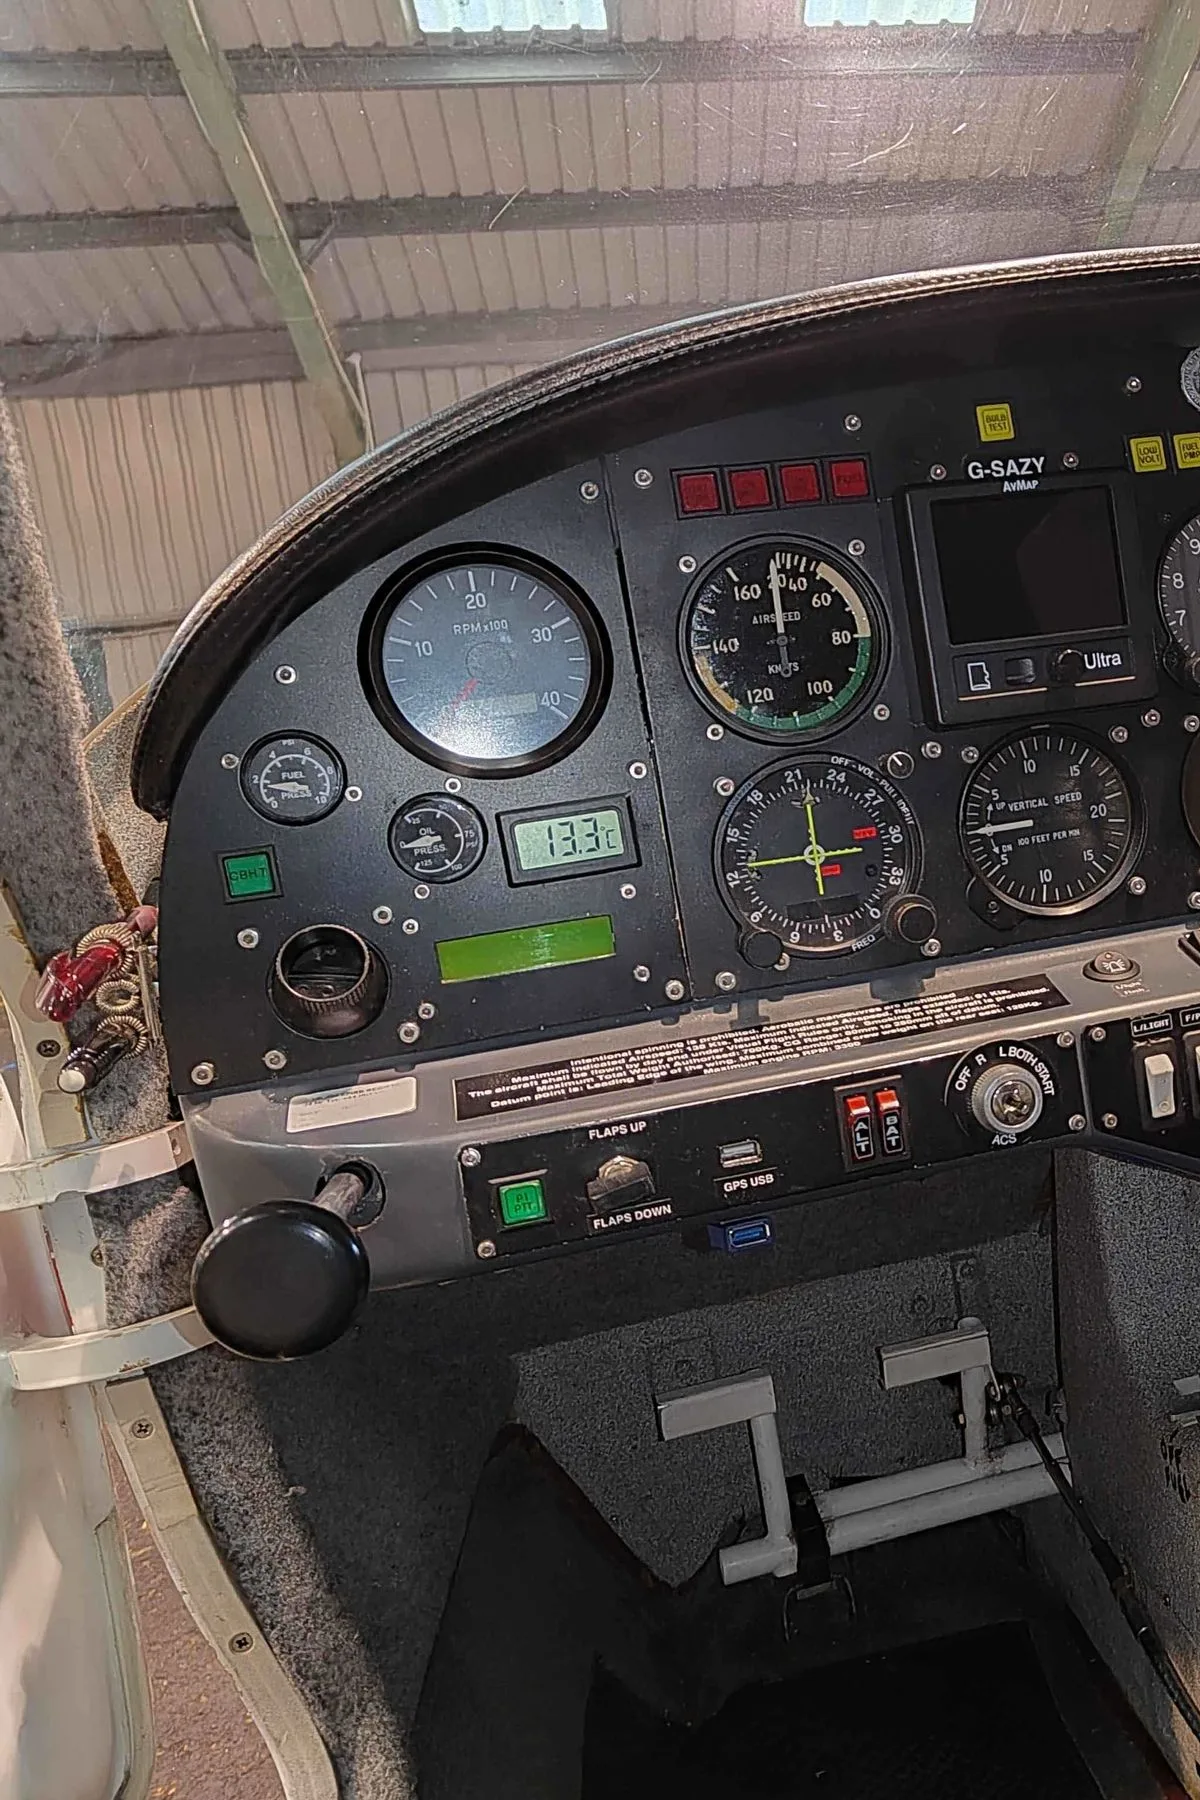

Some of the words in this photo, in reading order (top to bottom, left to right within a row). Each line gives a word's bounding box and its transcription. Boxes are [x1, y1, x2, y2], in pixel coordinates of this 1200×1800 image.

[1139, 447, 1157, 455] LOW
[968, 457, 1045, 479] G-SAZY
[1189, 539, 1200, 554] 9
[789, 577, 807, 591] 40
[1173, 573, 1184, 588] 8
[734, 583, 761, 600] 160
[465, 593, 486, 610] 20
[812, 592, 831, 608] 60
[752, 611, 801, 624] AIRSEED
[1175, 610, 1186, 626] 7
[453, 619, 508, 635] RPMx100
[531, 627, 552, 643] 30
[713, 638, 739, 653] 140
[832, 630, 850, 645] 80
[415, 641, 433, 657] 10
[768, 662, 799, 673] KNTS
[1084, 653, 1122, 670] Ultra
[747, 687, 774, 703] 120
[807, 680, 833, 695] 100
[541, 691, 560, 707] 40
[1024, 759, 1036, 773] 10
[1070, 765, 1080, 776] 15
[784, 769, 802, 784] 21
[826, 770, 846, 784] 24
[282, 790, 312, 799] PRESS
[747, 790, 763, 804] 18
[864, 788, 885, 805] 27
[991, 789, 999, 800] 5
[1009, 798, 1048, 811] VERTICAL
[1054, 792, 1082, 804] SPEED
[1090, 803, 1107, 819] 20
[419, 828, 435, 836] OIL
[726, 827, 740, 843] 15
[888, 825, 903, 843] 30
[414, 844, 446, 856] PRESS
[1083, 850, 1094, 861] 15
[1001, 855, 1008, 865] 5
[229, 867, 266, 881] CBHT
[726, 871, 740, 888] 12
[889, 867, 904, 885] 33
[1039, 869, 1052, 882] 10
[852, 935, 875, 951] FREQ
[570, 1052, 632, 1066] Intentional
[634, 1042, 684, 1055] spinning
[699, 1029, 759, 1043] prohibited.
[762, 1018, 814, 1032] Aerobatic
[816, 1007, 882, 1022] manoeuvres
[903, 992, 956, 1007] prohibited
[1133, 1019, 1170, 1033] L/LIGHT
[999, 1047, 1007, 1057] L
[1008, 1046, 1037, 1066] BOTH
[704, 1060, 759, 1074] Maximum
[761, 1053, 800, 1064] engine
[802, 1047, 832, 1057] RPM:
[976, 1054, 987, 1068] R
[955, 1067, 972, 1091] OFF
[1035, 1062, 1056, 1097] START
[588, 1126, 628, 1140] FLAPS
[629, 1121, 646, 1134] UP
[855, 1121, 869, 1152] ALT
[886, 1116, 900, 1147] BAT
[992, 1133, 1017, 1146] ACS
[723, 1179, 748, 1192] GPS
[750, 1174, 774, 1188] USB
[593, 1213, 633, 1229] FLAPS
[634, 1204, 672, 1220] DOWN
